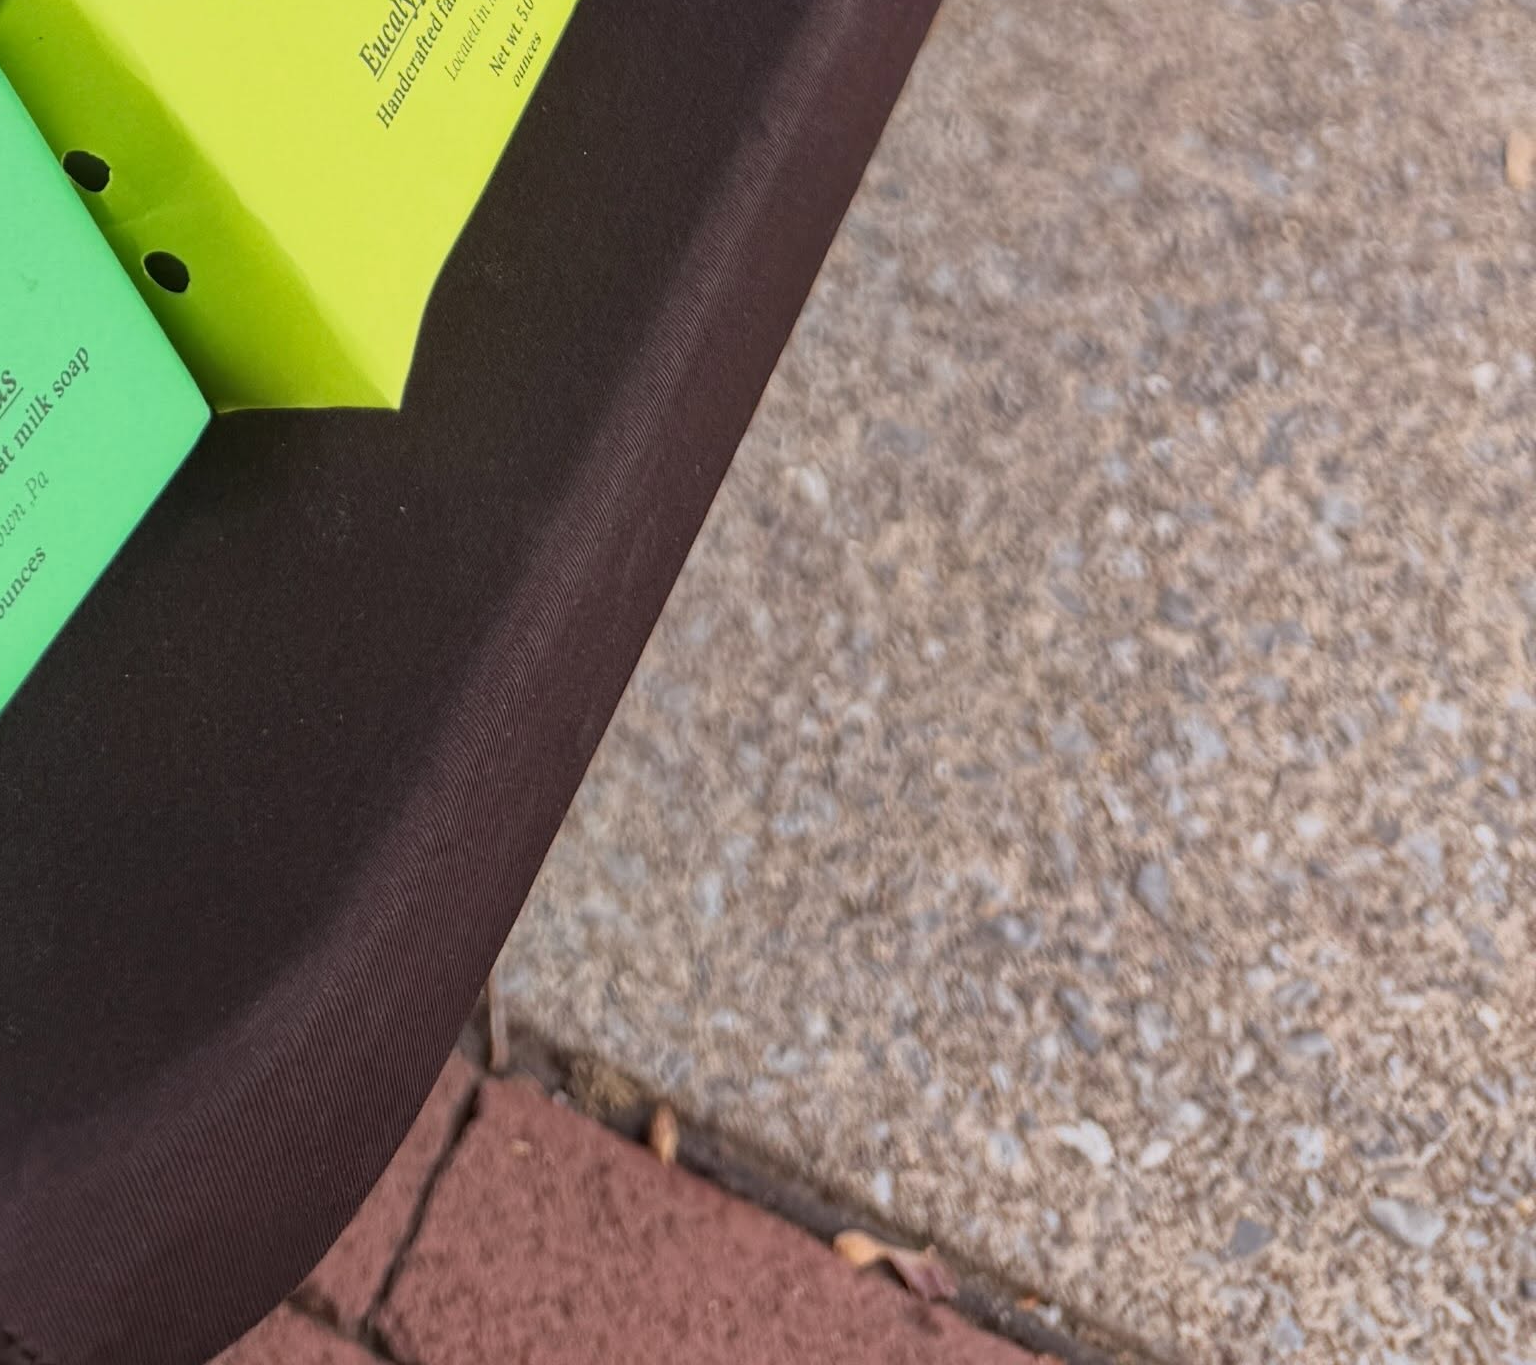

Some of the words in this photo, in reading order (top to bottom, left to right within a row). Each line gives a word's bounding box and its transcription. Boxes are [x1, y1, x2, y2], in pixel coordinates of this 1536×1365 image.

[375, 13, 443, 129] Handcrafted
[444, 18, 481, 81] Located
[477, 4, 490, 26] in
[489, 46, 511, 78] Net
[507, 20, 523, 47] wt.
[513, 31, 542, 87] ounces
[14, 394, 54, 449] milk
[52, 346, 90, 399] soap
